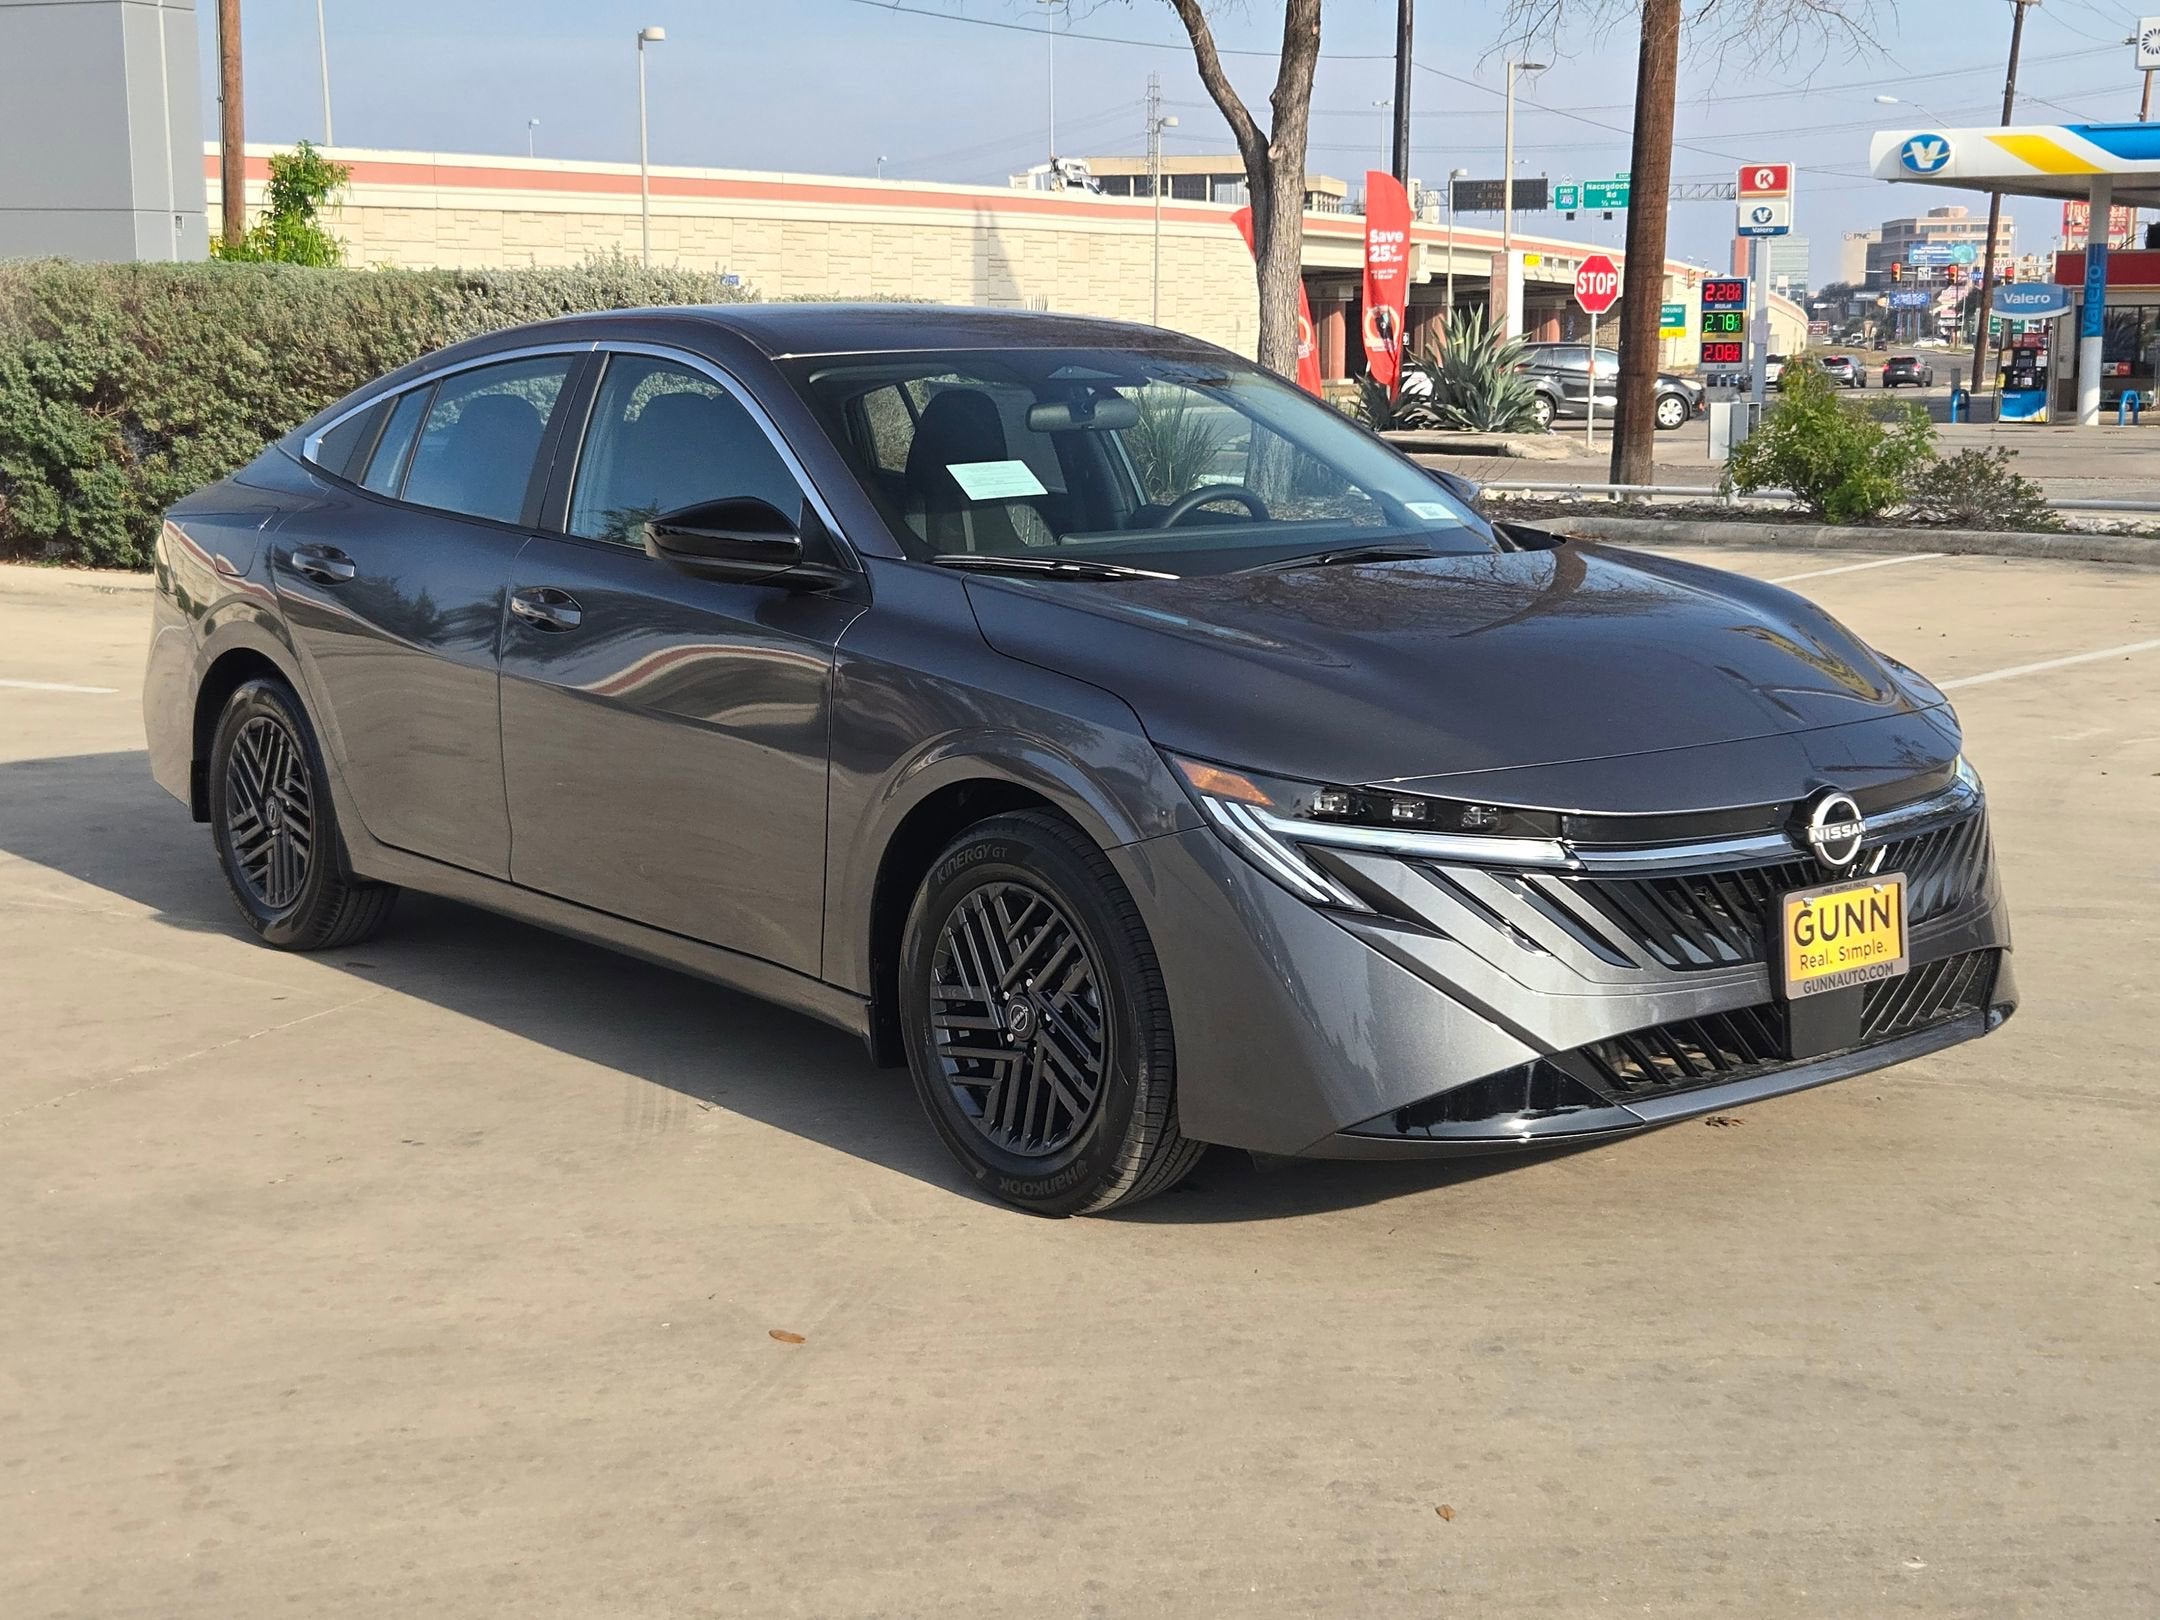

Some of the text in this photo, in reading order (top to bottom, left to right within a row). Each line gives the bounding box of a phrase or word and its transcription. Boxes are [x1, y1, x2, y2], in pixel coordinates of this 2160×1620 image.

[1586, 182, 1630, 190] Nacogdoch
[1370, 229, 1404, 243] Save
[1577, 271, 1618, 295] STOP
[2003, 293, 2050, 304] Valero
[2083, 265, 2102, 335] Valero
[1808, 820, 1866, 843] NISSAN
[1794, 894, 1890, 947] GUNN
[1800, 948, 1833, 971] Real.
[1803, 962, 1894, 994] GUNNAUTO.COM
